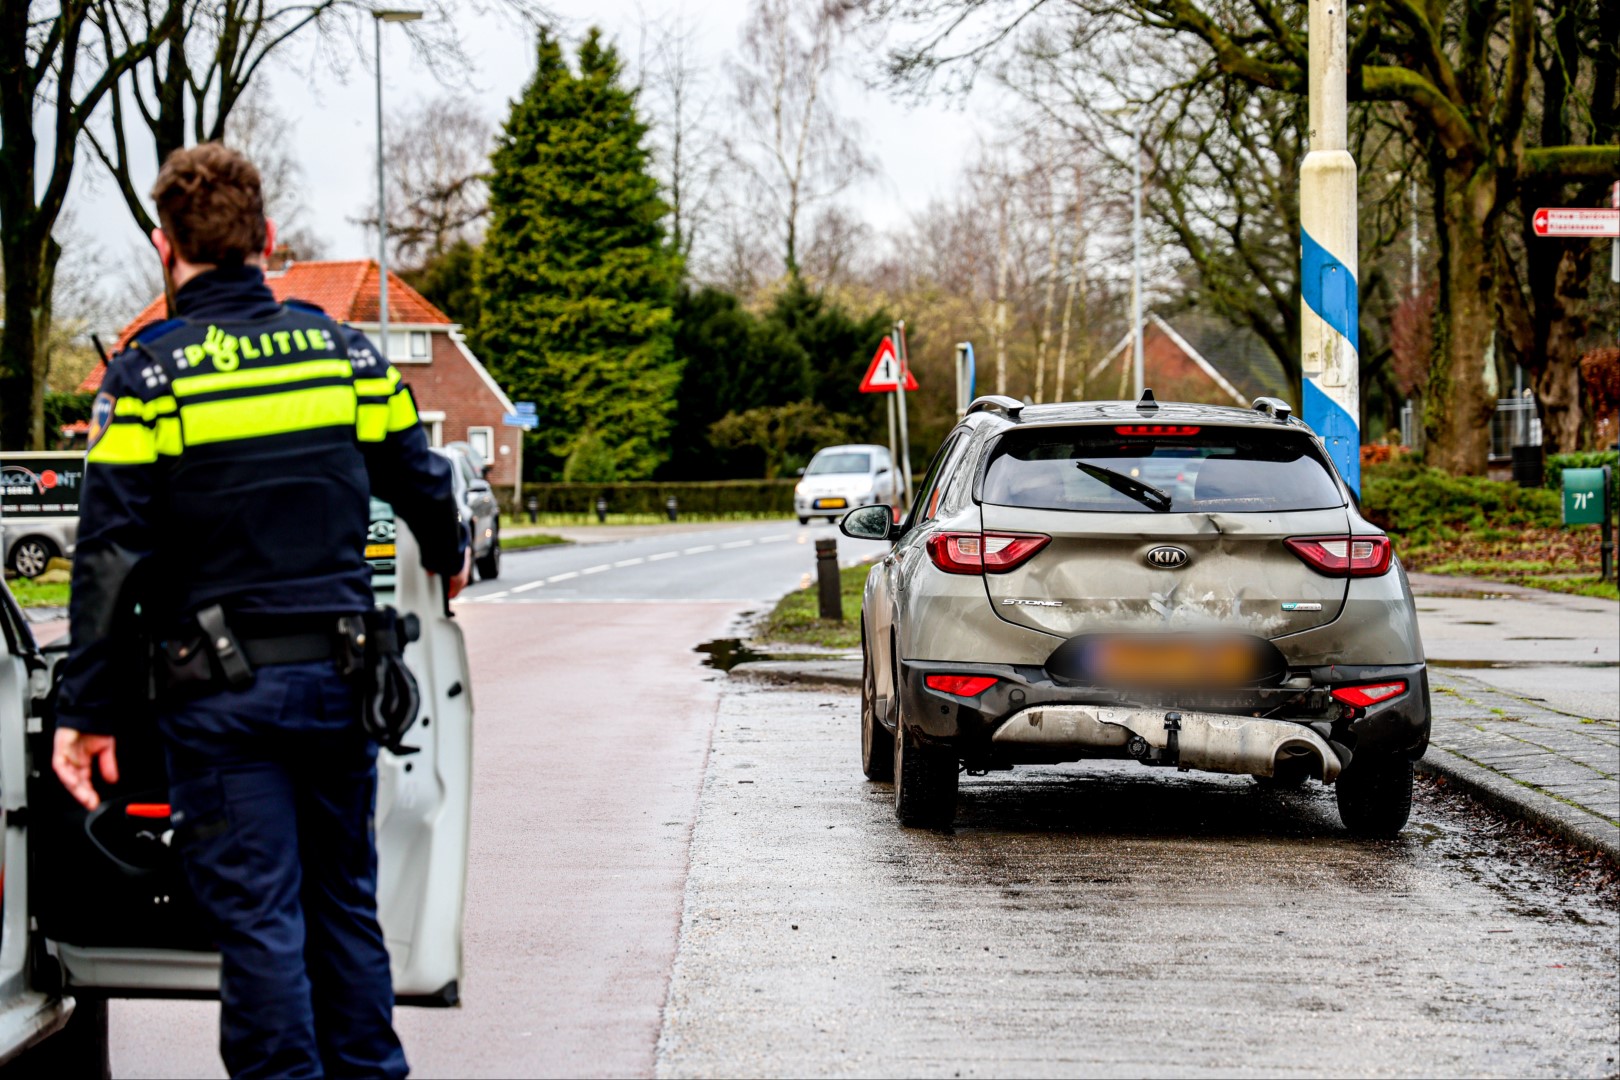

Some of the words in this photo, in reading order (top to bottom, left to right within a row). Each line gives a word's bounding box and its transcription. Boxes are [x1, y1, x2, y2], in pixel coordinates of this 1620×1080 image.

[184, 325, 328, 371] POLITIE
[1154, 551, 1181, 563] KIA
[1001, 598, 1063, 607] STONIC
